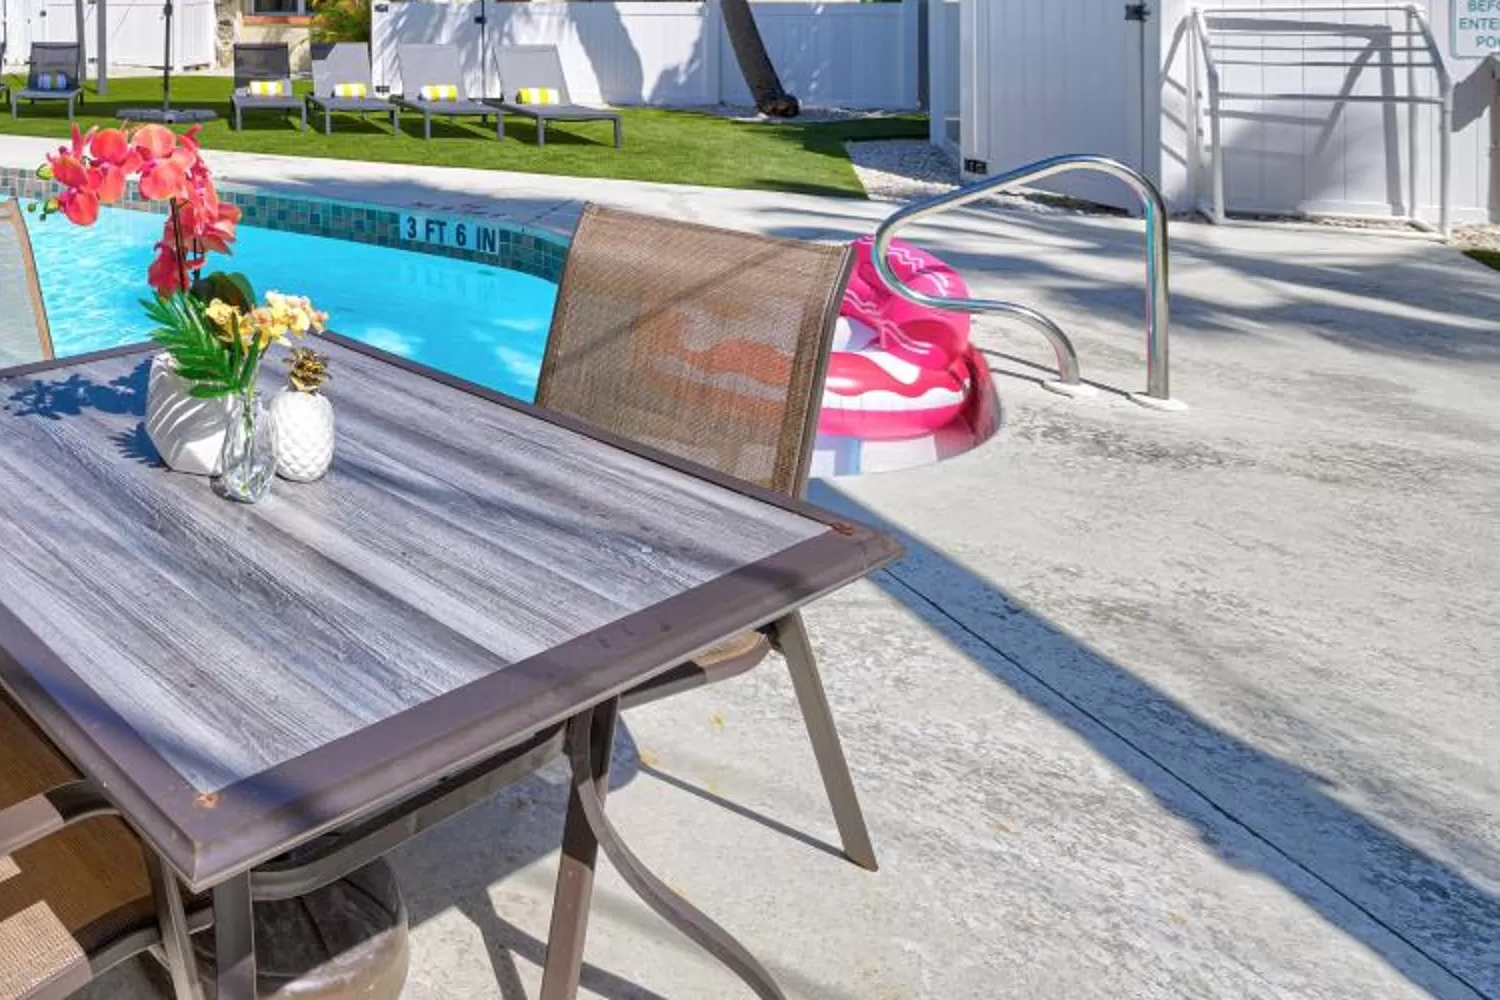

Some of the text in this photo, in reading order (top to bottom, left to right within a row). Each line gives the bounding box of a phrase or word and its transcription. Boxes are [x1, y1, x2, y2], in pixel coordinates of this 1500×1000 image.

[1476, 36, 1500, 48] PO
[406, 216, 495, 252] 3 FT 6 IN
